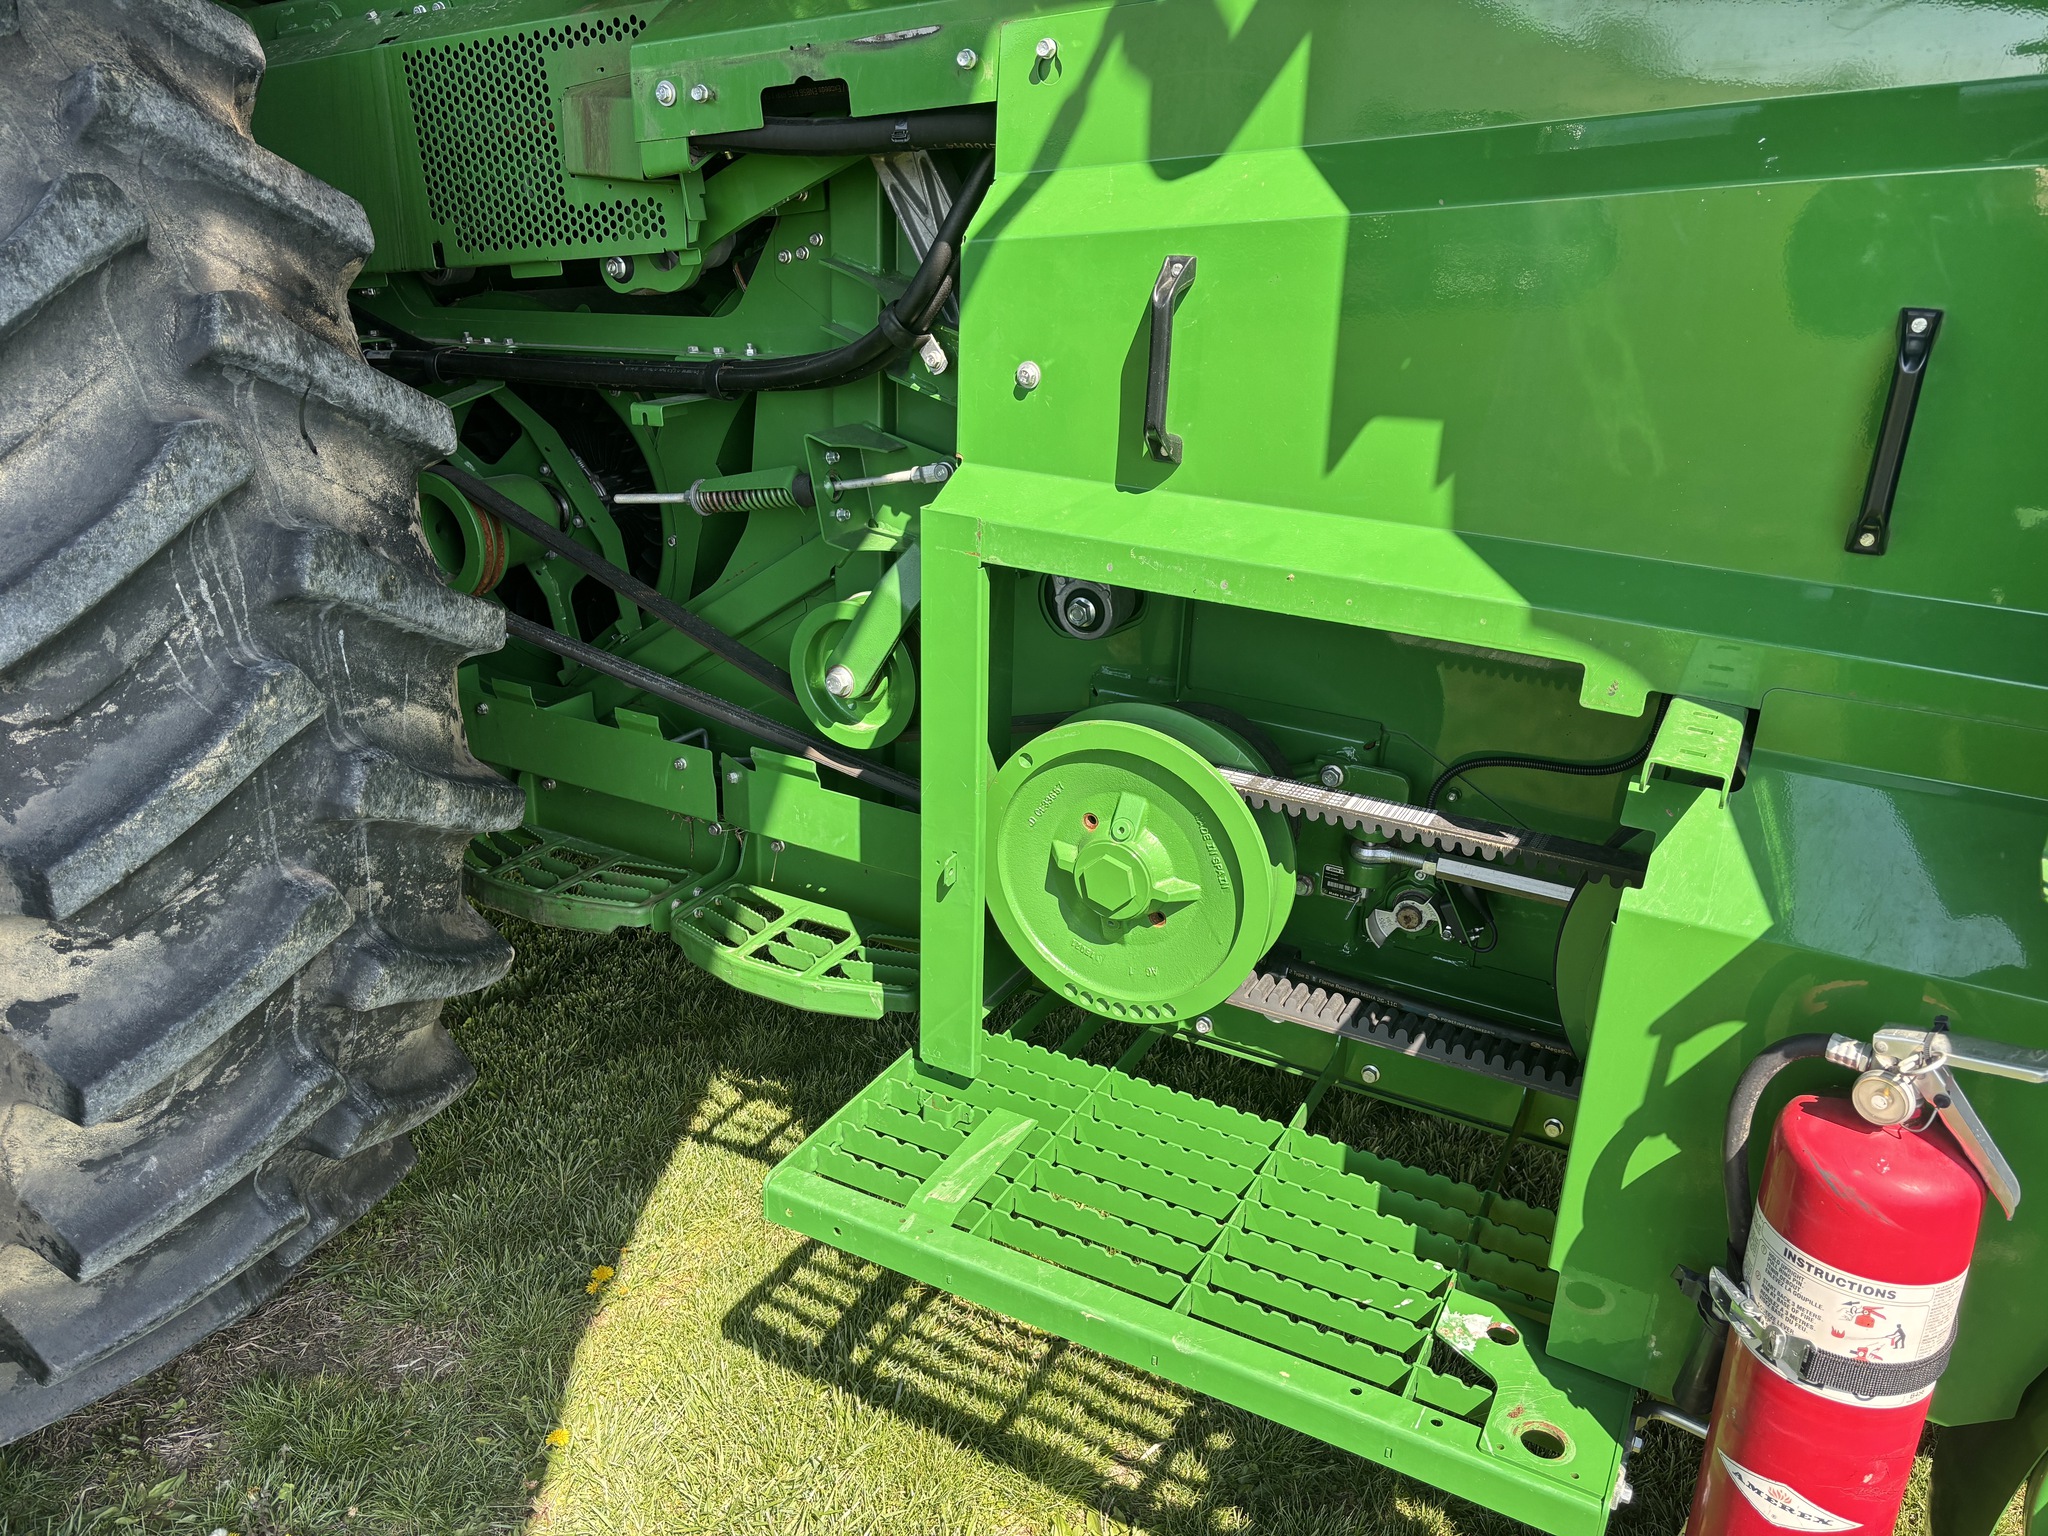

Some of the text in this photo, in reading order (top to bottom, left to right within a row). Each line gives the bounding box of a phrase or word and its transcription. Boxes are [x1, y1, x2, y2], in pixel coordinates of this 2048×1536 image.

[1211, 856, 1230, 890] SPAIN
[1318, 978, 1335, 988] Flame
[1335, 983, 1360, 996] Resistant
[1767, 1257, 1779, 1271] PULL
[1779, 1267, 1791, 1280] RING
[1768, 1251, 1781, 1265] HOLD
[1764, 1269, 1785, 1290] ENLEVEZ
[1784, 1286, 1792, 1294] LA
[1766, 1263, 1780, 1279] TENIR
[1783, 1247, 1897, 1300] INSTRUCTIONS
[1760, 1290, 1780, 1310] RECULEZ
[1761, 1283, 1770, 1294] AIM
[1769, 1290, 1776, 1299] AT
[1776, 1297, 1791, 1311] BASE
[1791, 1307, 1800, 1316] OF
[1762, 1278, 1776, 1292] START
[1776, 1289, 1791, 1305] BACK
[1770, 1305, 1784, 1320] BASE
[1784, 1316, 1793, 1325] DU
[1776, 1319, 1795, 1335] LEVER
[1732, 1470, 1834, 1527] AMEREX
